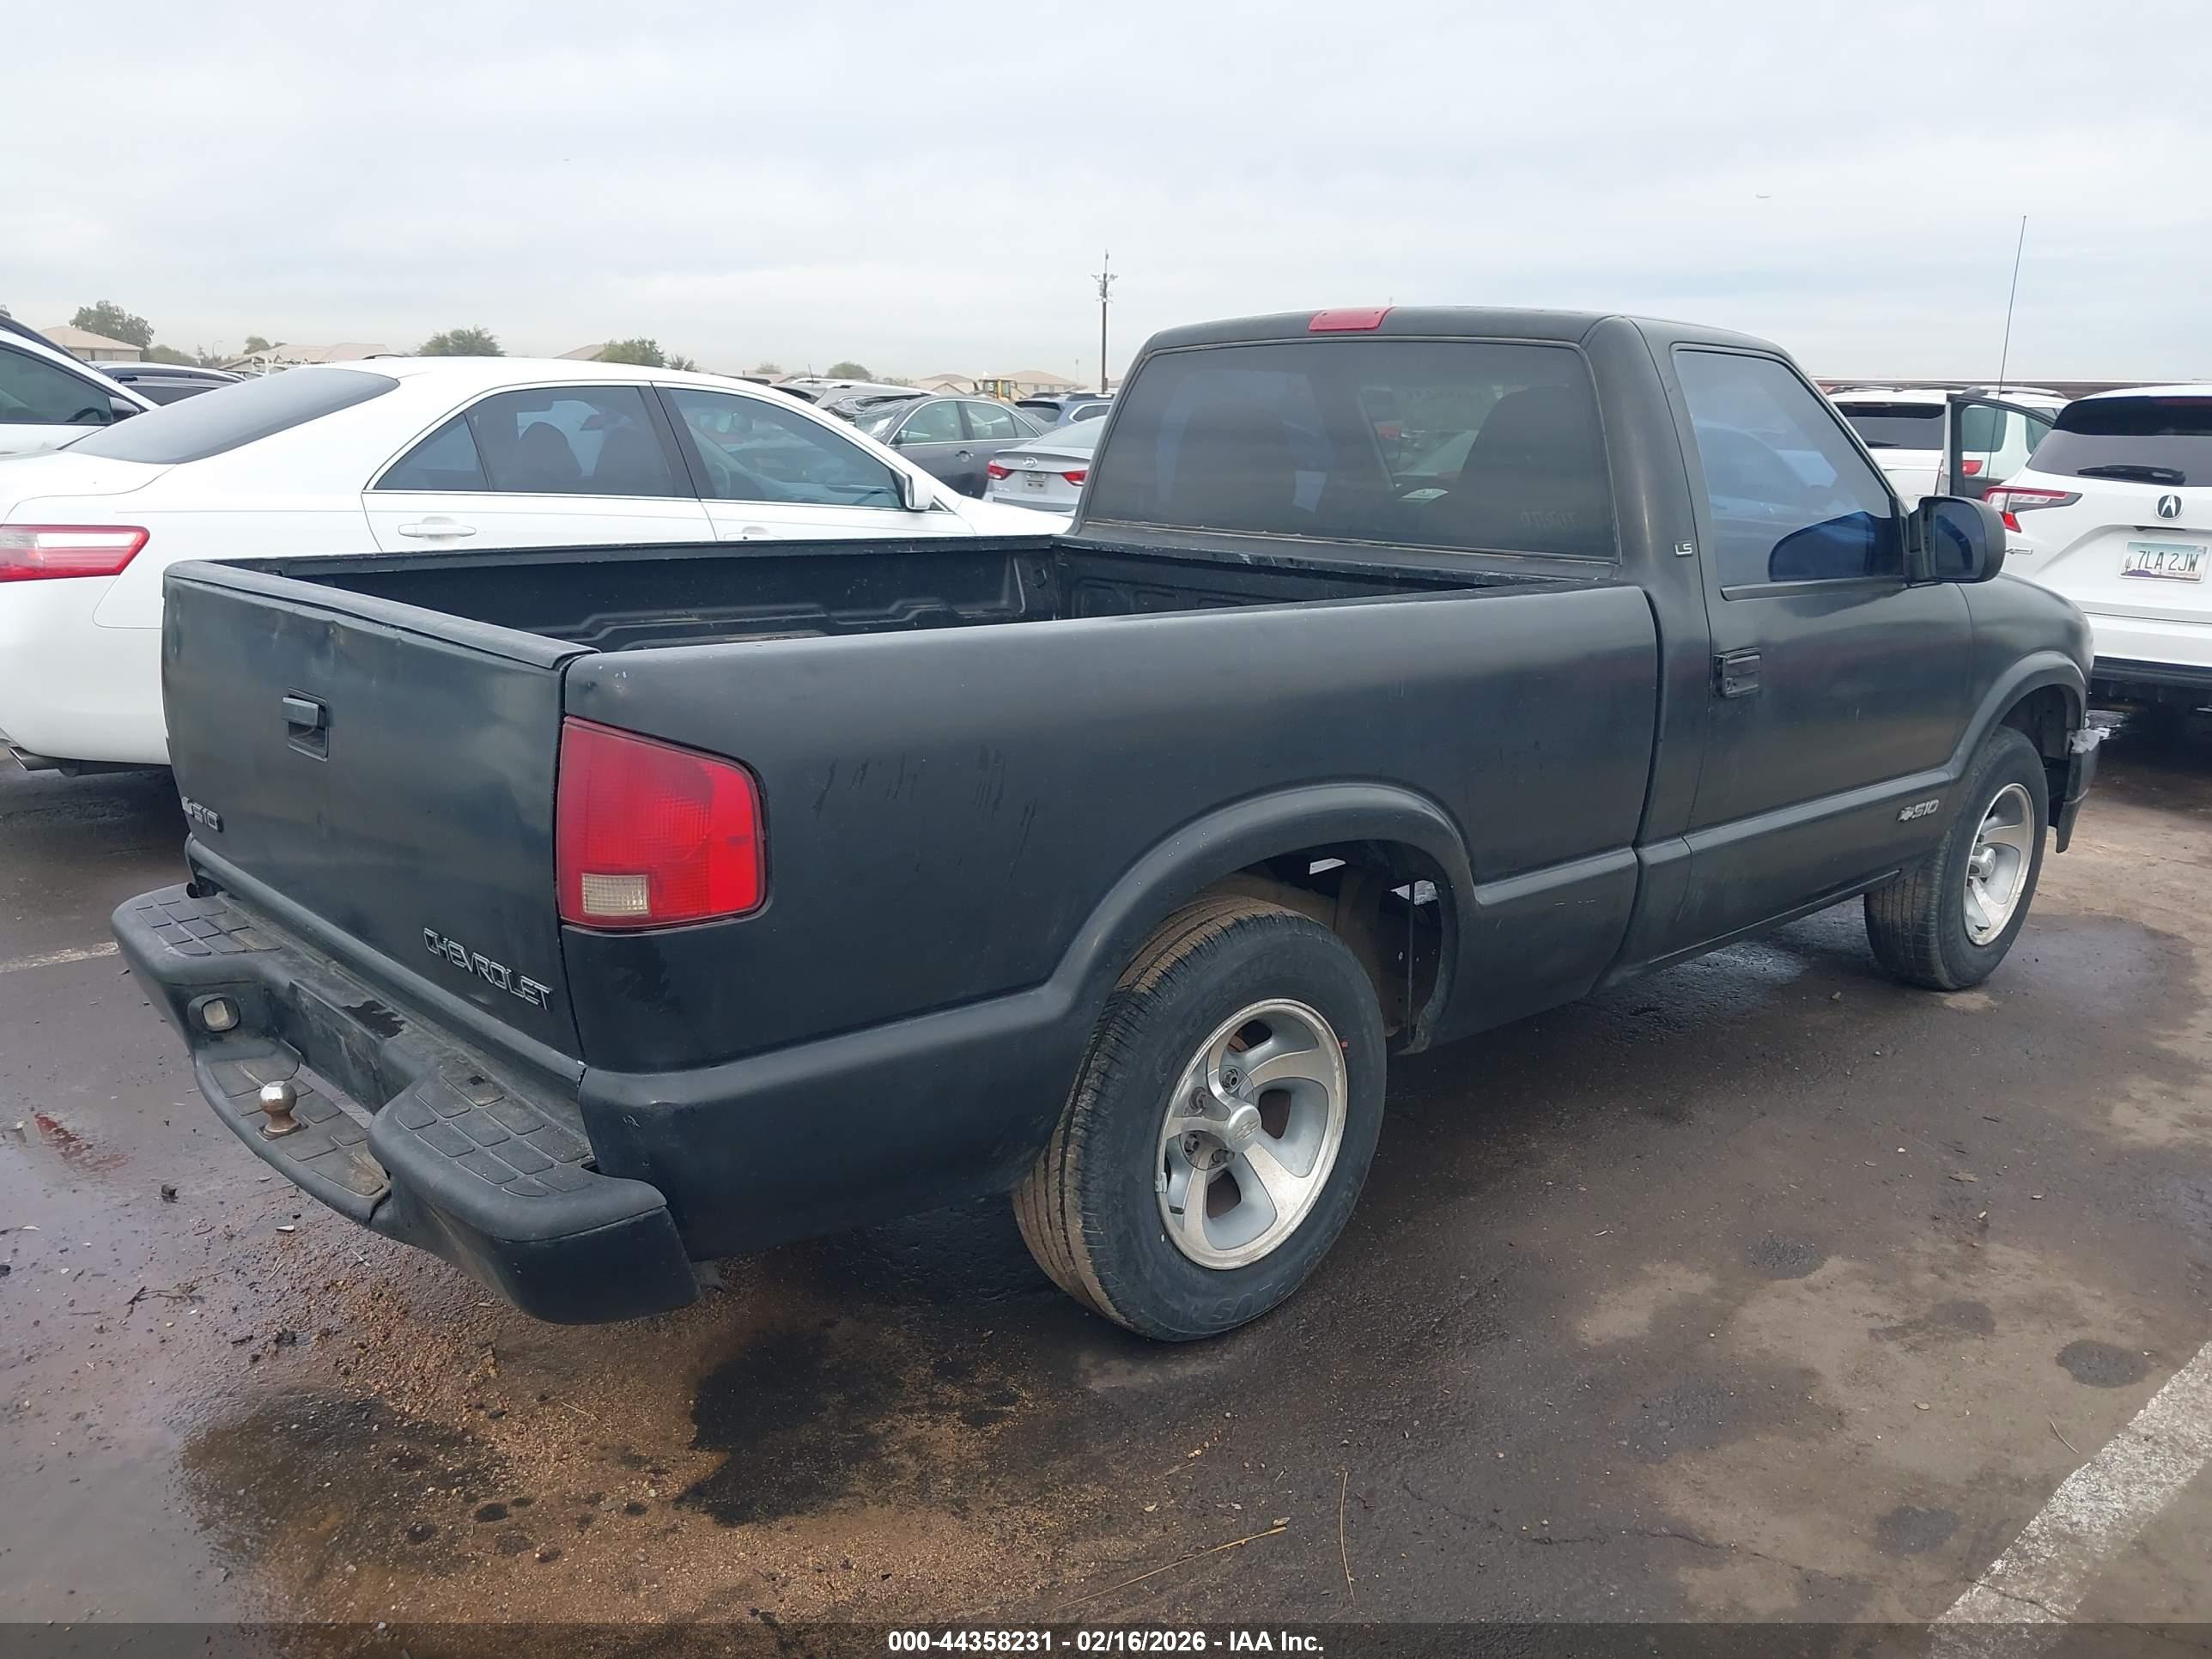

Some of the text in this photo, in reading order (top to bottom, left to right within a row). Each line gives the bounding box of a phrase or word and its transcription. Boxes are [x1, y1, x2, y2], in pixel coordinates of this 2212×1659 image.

[1674, 543, 1692, 555] LS
[2136, 550, 2199, 573] 7LA 2JW
[1911, 799, 1940, 818] S10
[422, 927, 553, 1011] CHEVROLET
